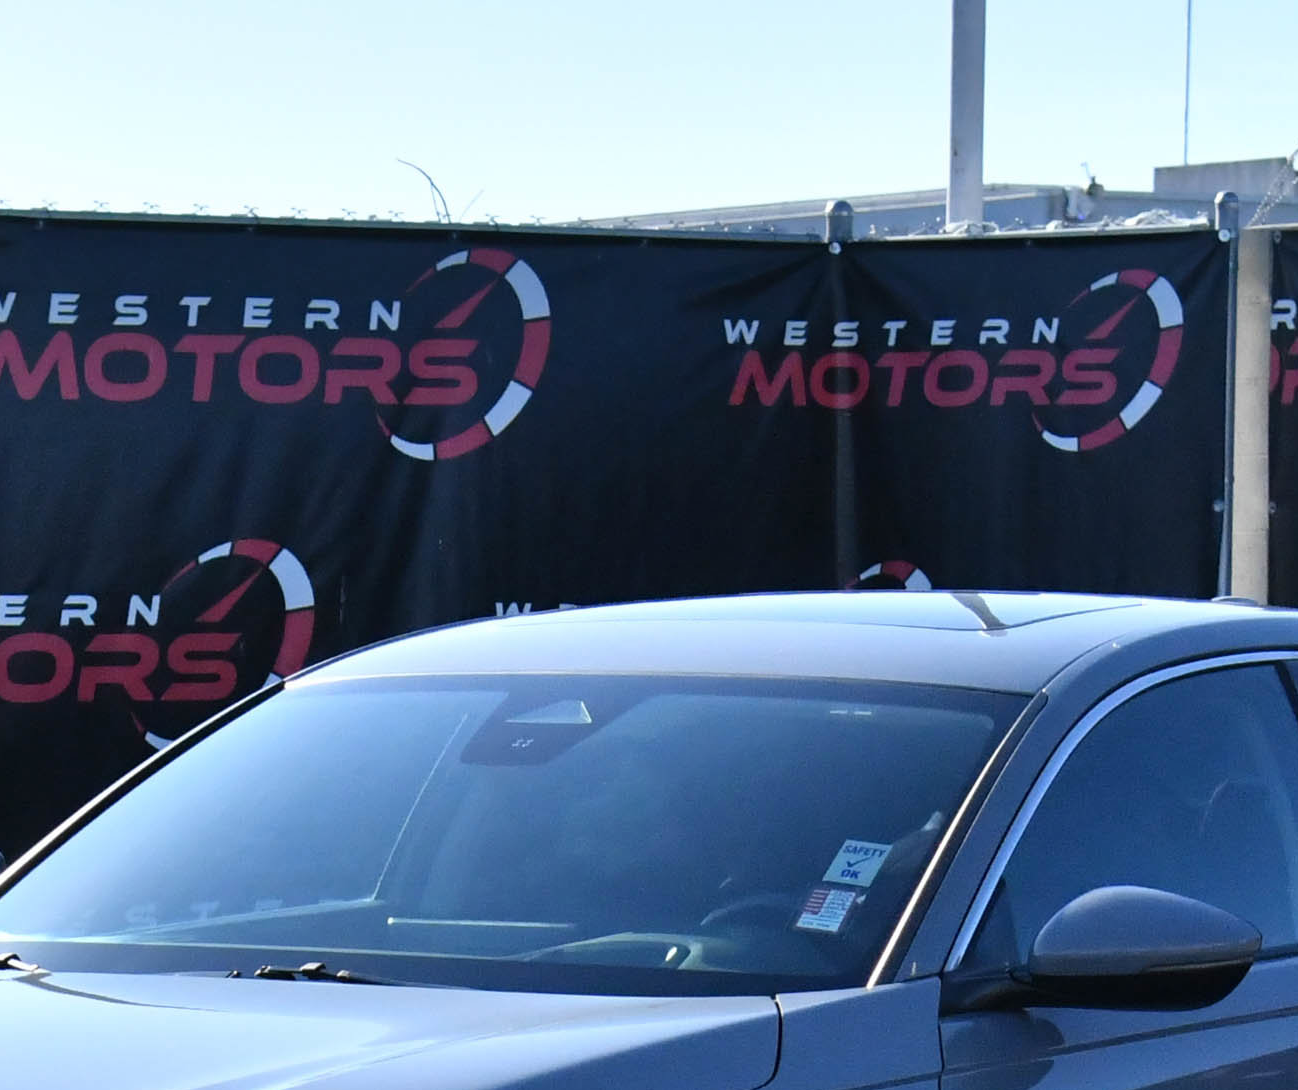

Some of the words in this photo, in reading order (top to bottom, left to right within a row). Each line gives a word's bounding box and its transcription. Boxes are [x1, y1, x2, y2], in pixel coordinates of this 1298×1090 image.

[723, 317, 1060, 347] WESTERN
[728, 348, 1119, 409] MOTORS
[843, 844, 886, 858] SAFETY
[841, 869, 861, 880] OK
